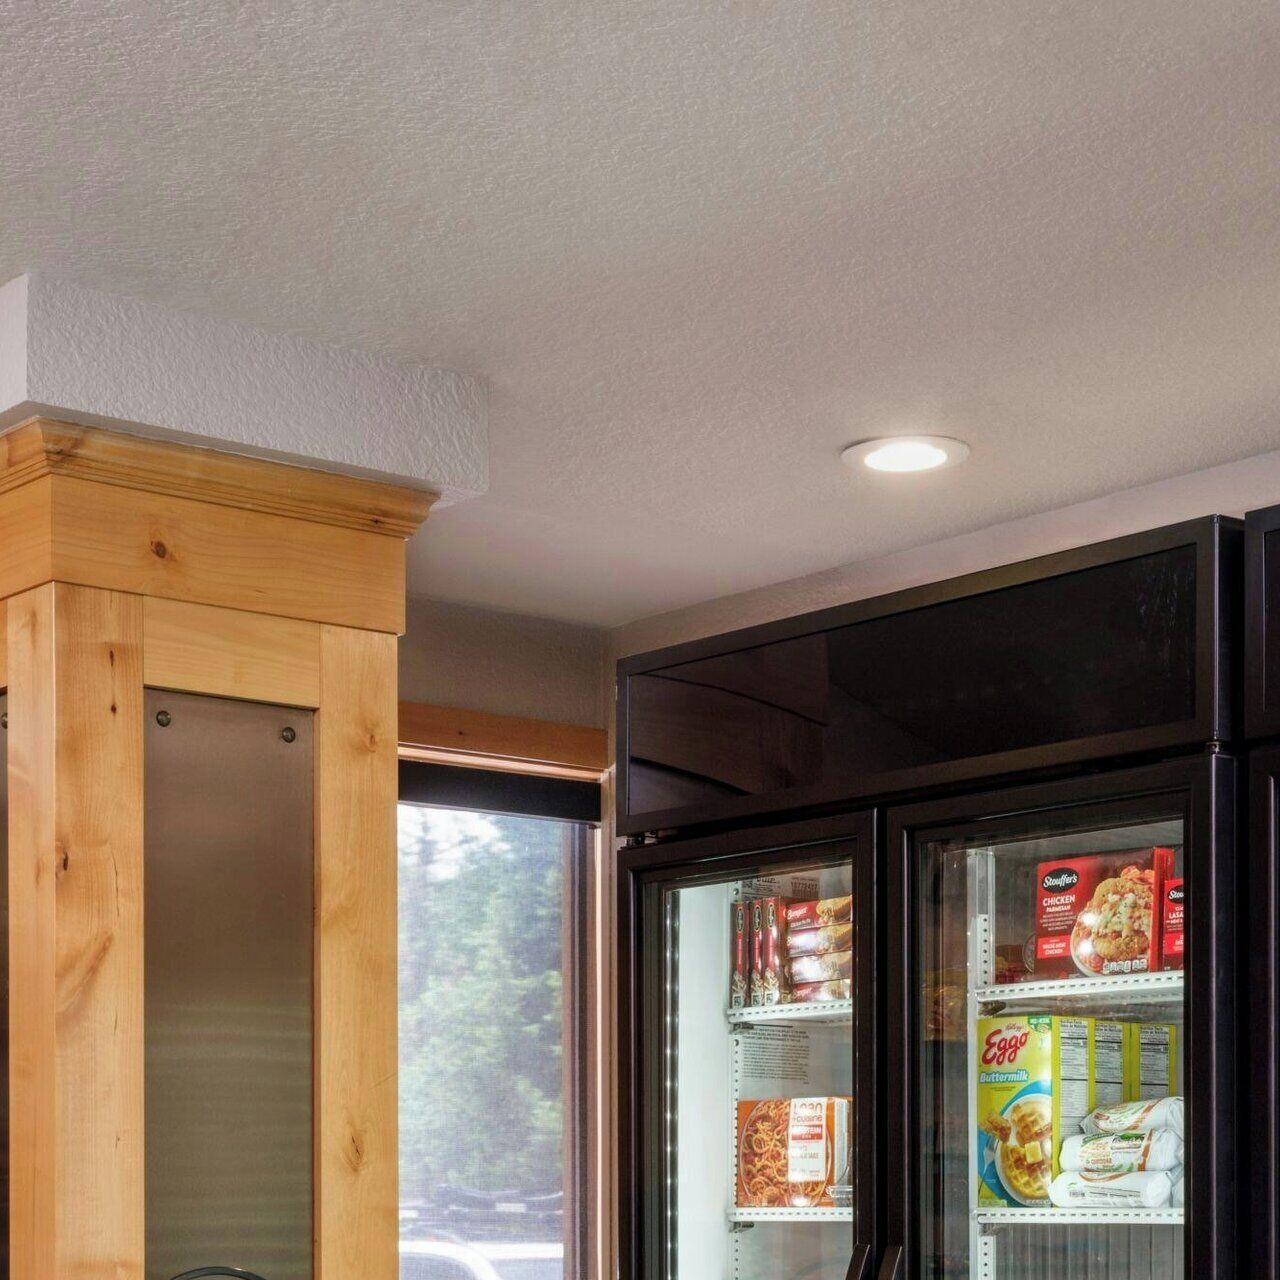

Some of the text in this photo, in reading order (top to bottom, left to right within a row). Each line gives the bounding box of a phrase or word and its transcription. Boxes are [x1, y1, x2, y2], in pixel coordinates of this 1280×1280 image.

[1043, 871, 1079, 888] Stouffer's
[1042, 894, 1075, 907] CHICKEN
[981, 1027, 1029, 1065] Eggo
[980, 1069, 1028, 1083] Buttermilk
